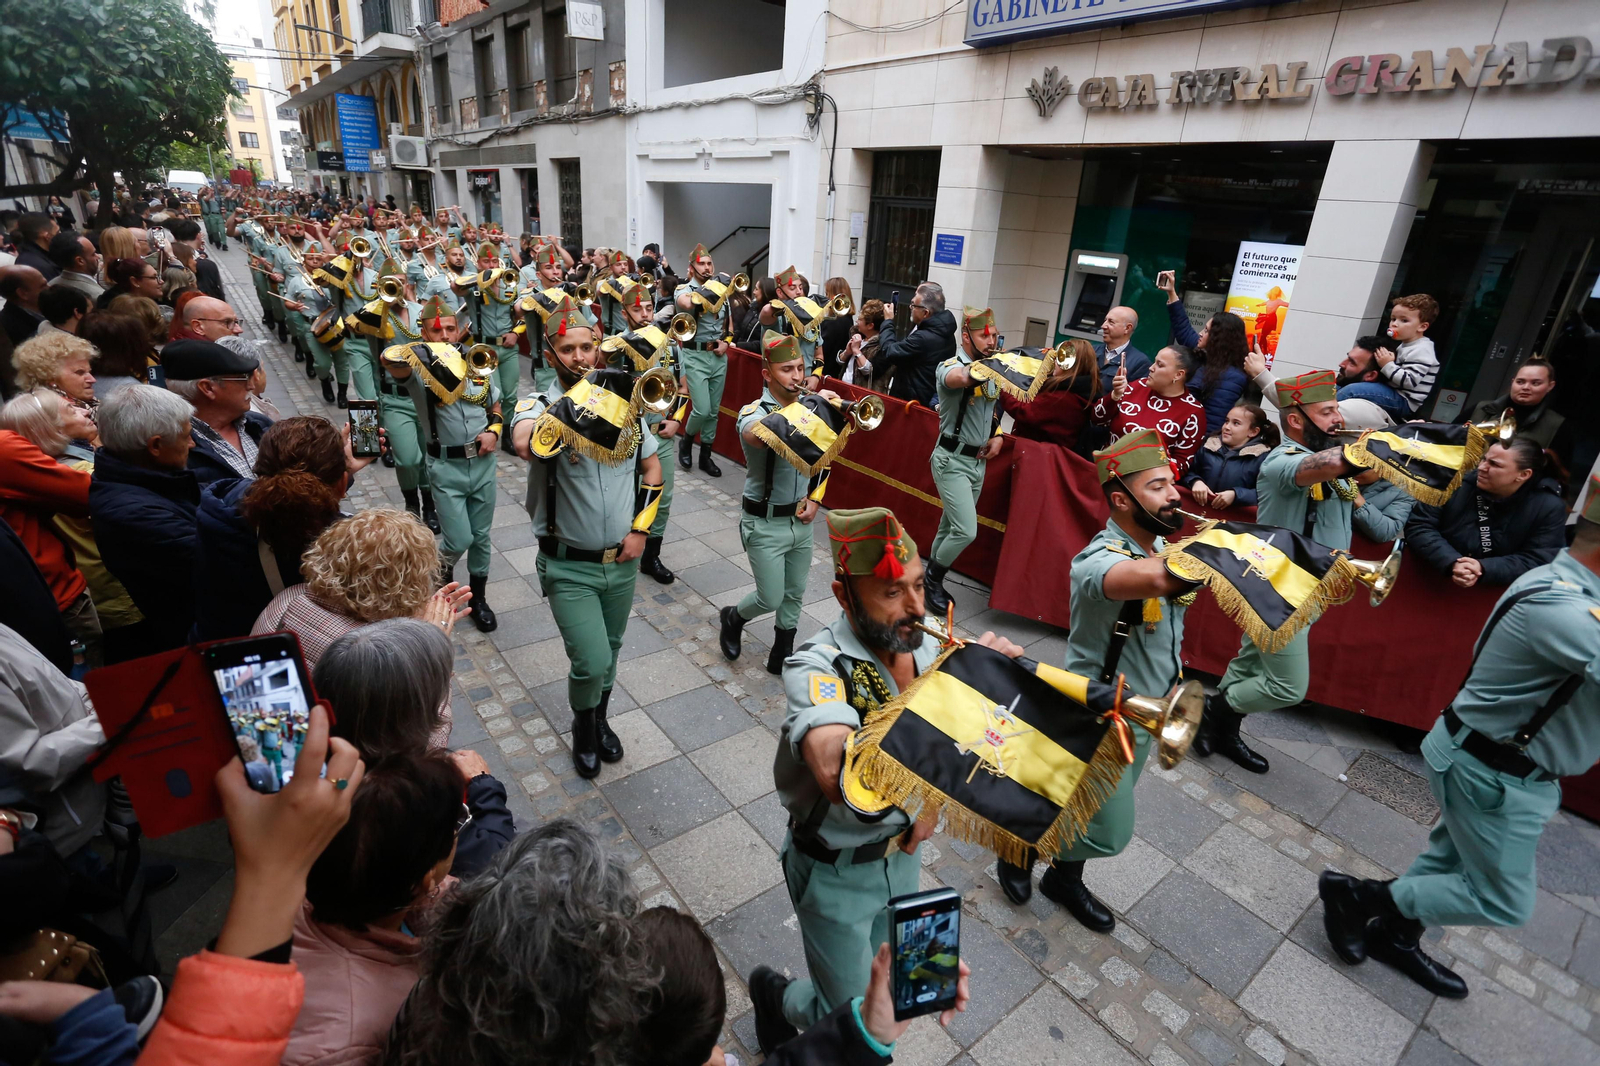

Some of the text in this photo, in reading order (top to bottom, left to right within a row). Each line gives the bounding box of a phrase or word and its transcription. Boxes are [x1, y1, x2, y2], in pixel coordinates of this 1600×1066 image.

[574, 11, 598, 27] P&P
[973, 0, 1104, 28] GABIN
[1078, 35, 1600, 110] CAJA RURAL GRANAD
[345, 157, 370, 165] IMPRENT
[1241, 260, 1288, 271] te mereces
[1243, 251, 1298, 265] El futuro que
[1239, 268, 1297, 282] comienza aqu
[1479, 526, 1493, 553] BIMBA
